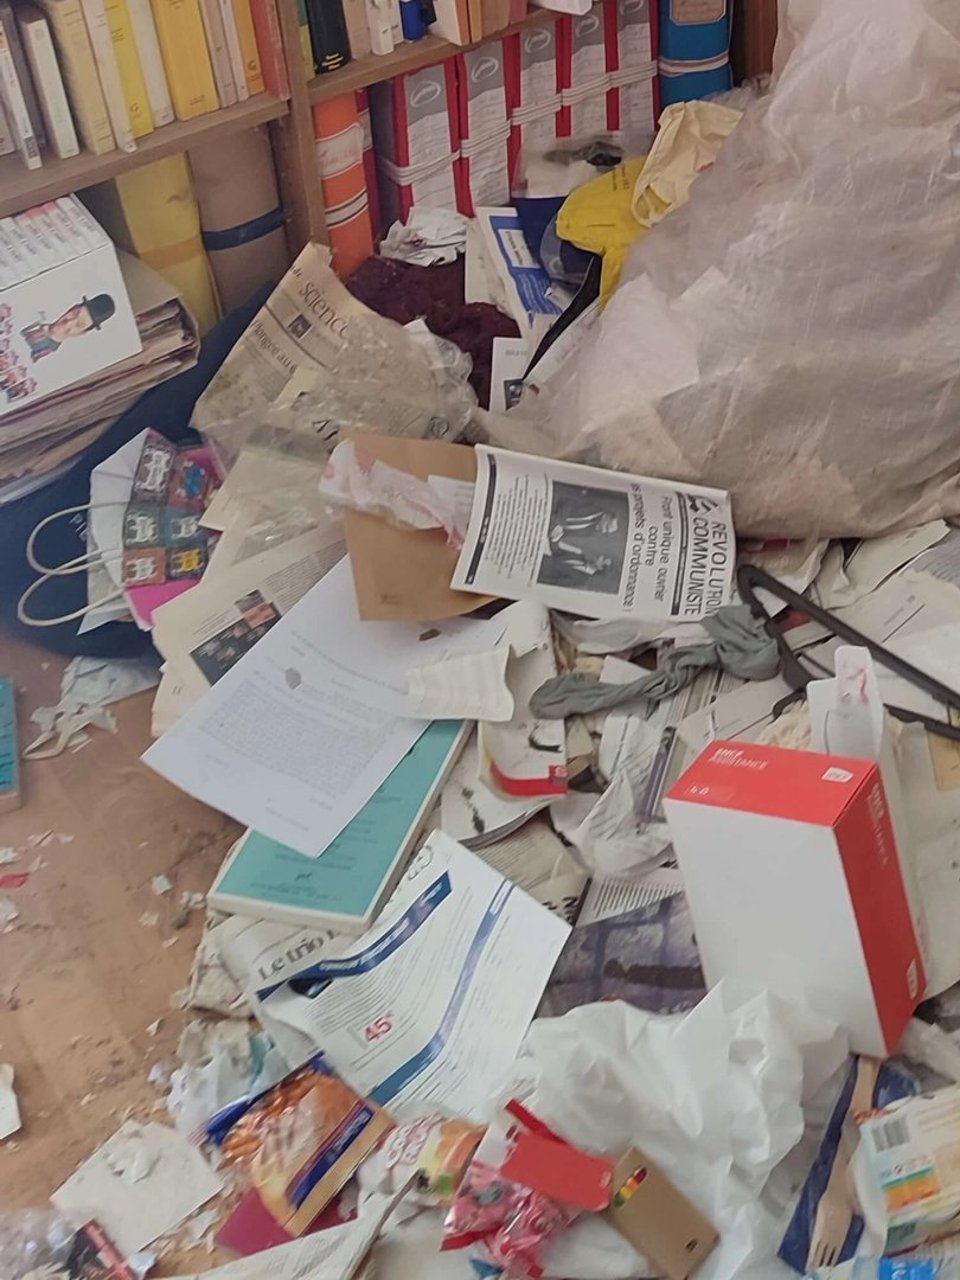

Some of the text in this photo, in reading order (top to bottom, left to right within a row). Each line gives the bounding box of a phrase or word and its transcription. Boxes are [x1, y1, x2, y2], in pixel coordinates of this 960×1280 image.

[633, 495, 645, 529] projets
[644, 526, 660, 567] contre
[657, 521, 674, 564] unique
[684, 517, 711, 615] COMMUNISTE
[654, 568, 668, 602] ouvrier
[283, 933, 326, 964] trio
